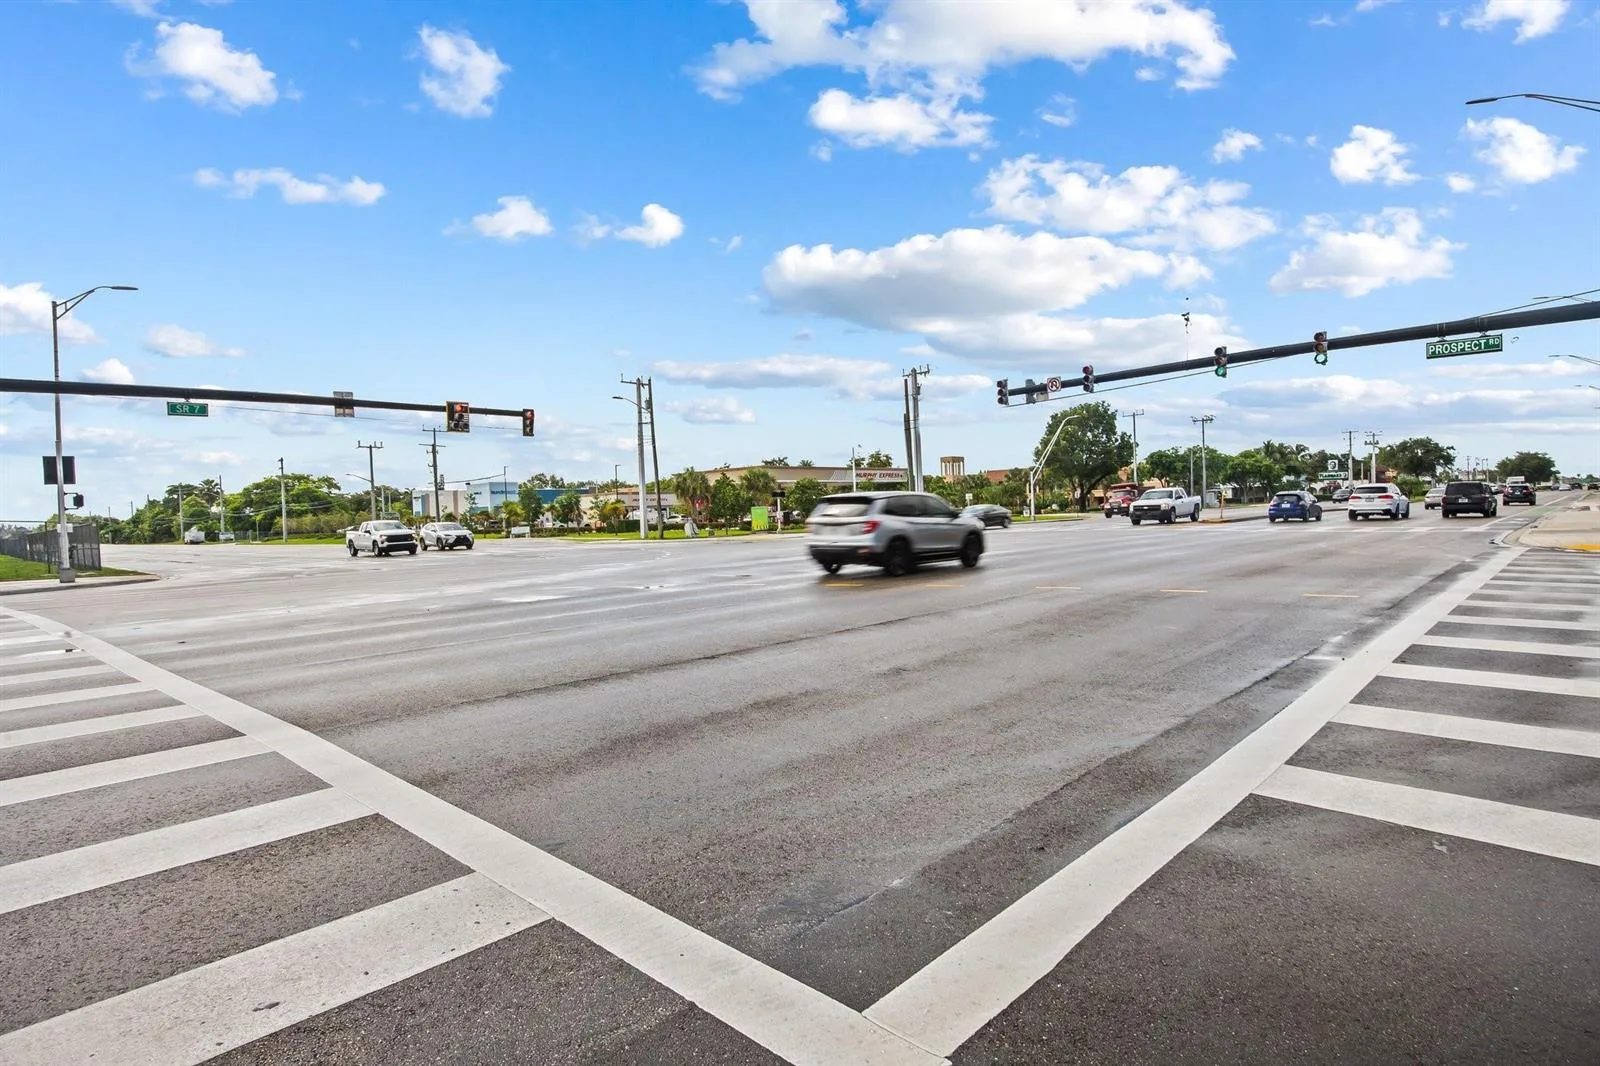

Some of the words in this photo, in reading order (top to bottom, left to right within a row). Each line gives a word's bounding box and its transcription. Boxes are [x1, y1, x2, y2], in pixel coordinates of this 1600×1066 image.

[1429, 339, 1487, 355] PROSPECT
[176, 404, 189, 413] SR
[193, 405, 200, 413] 7
